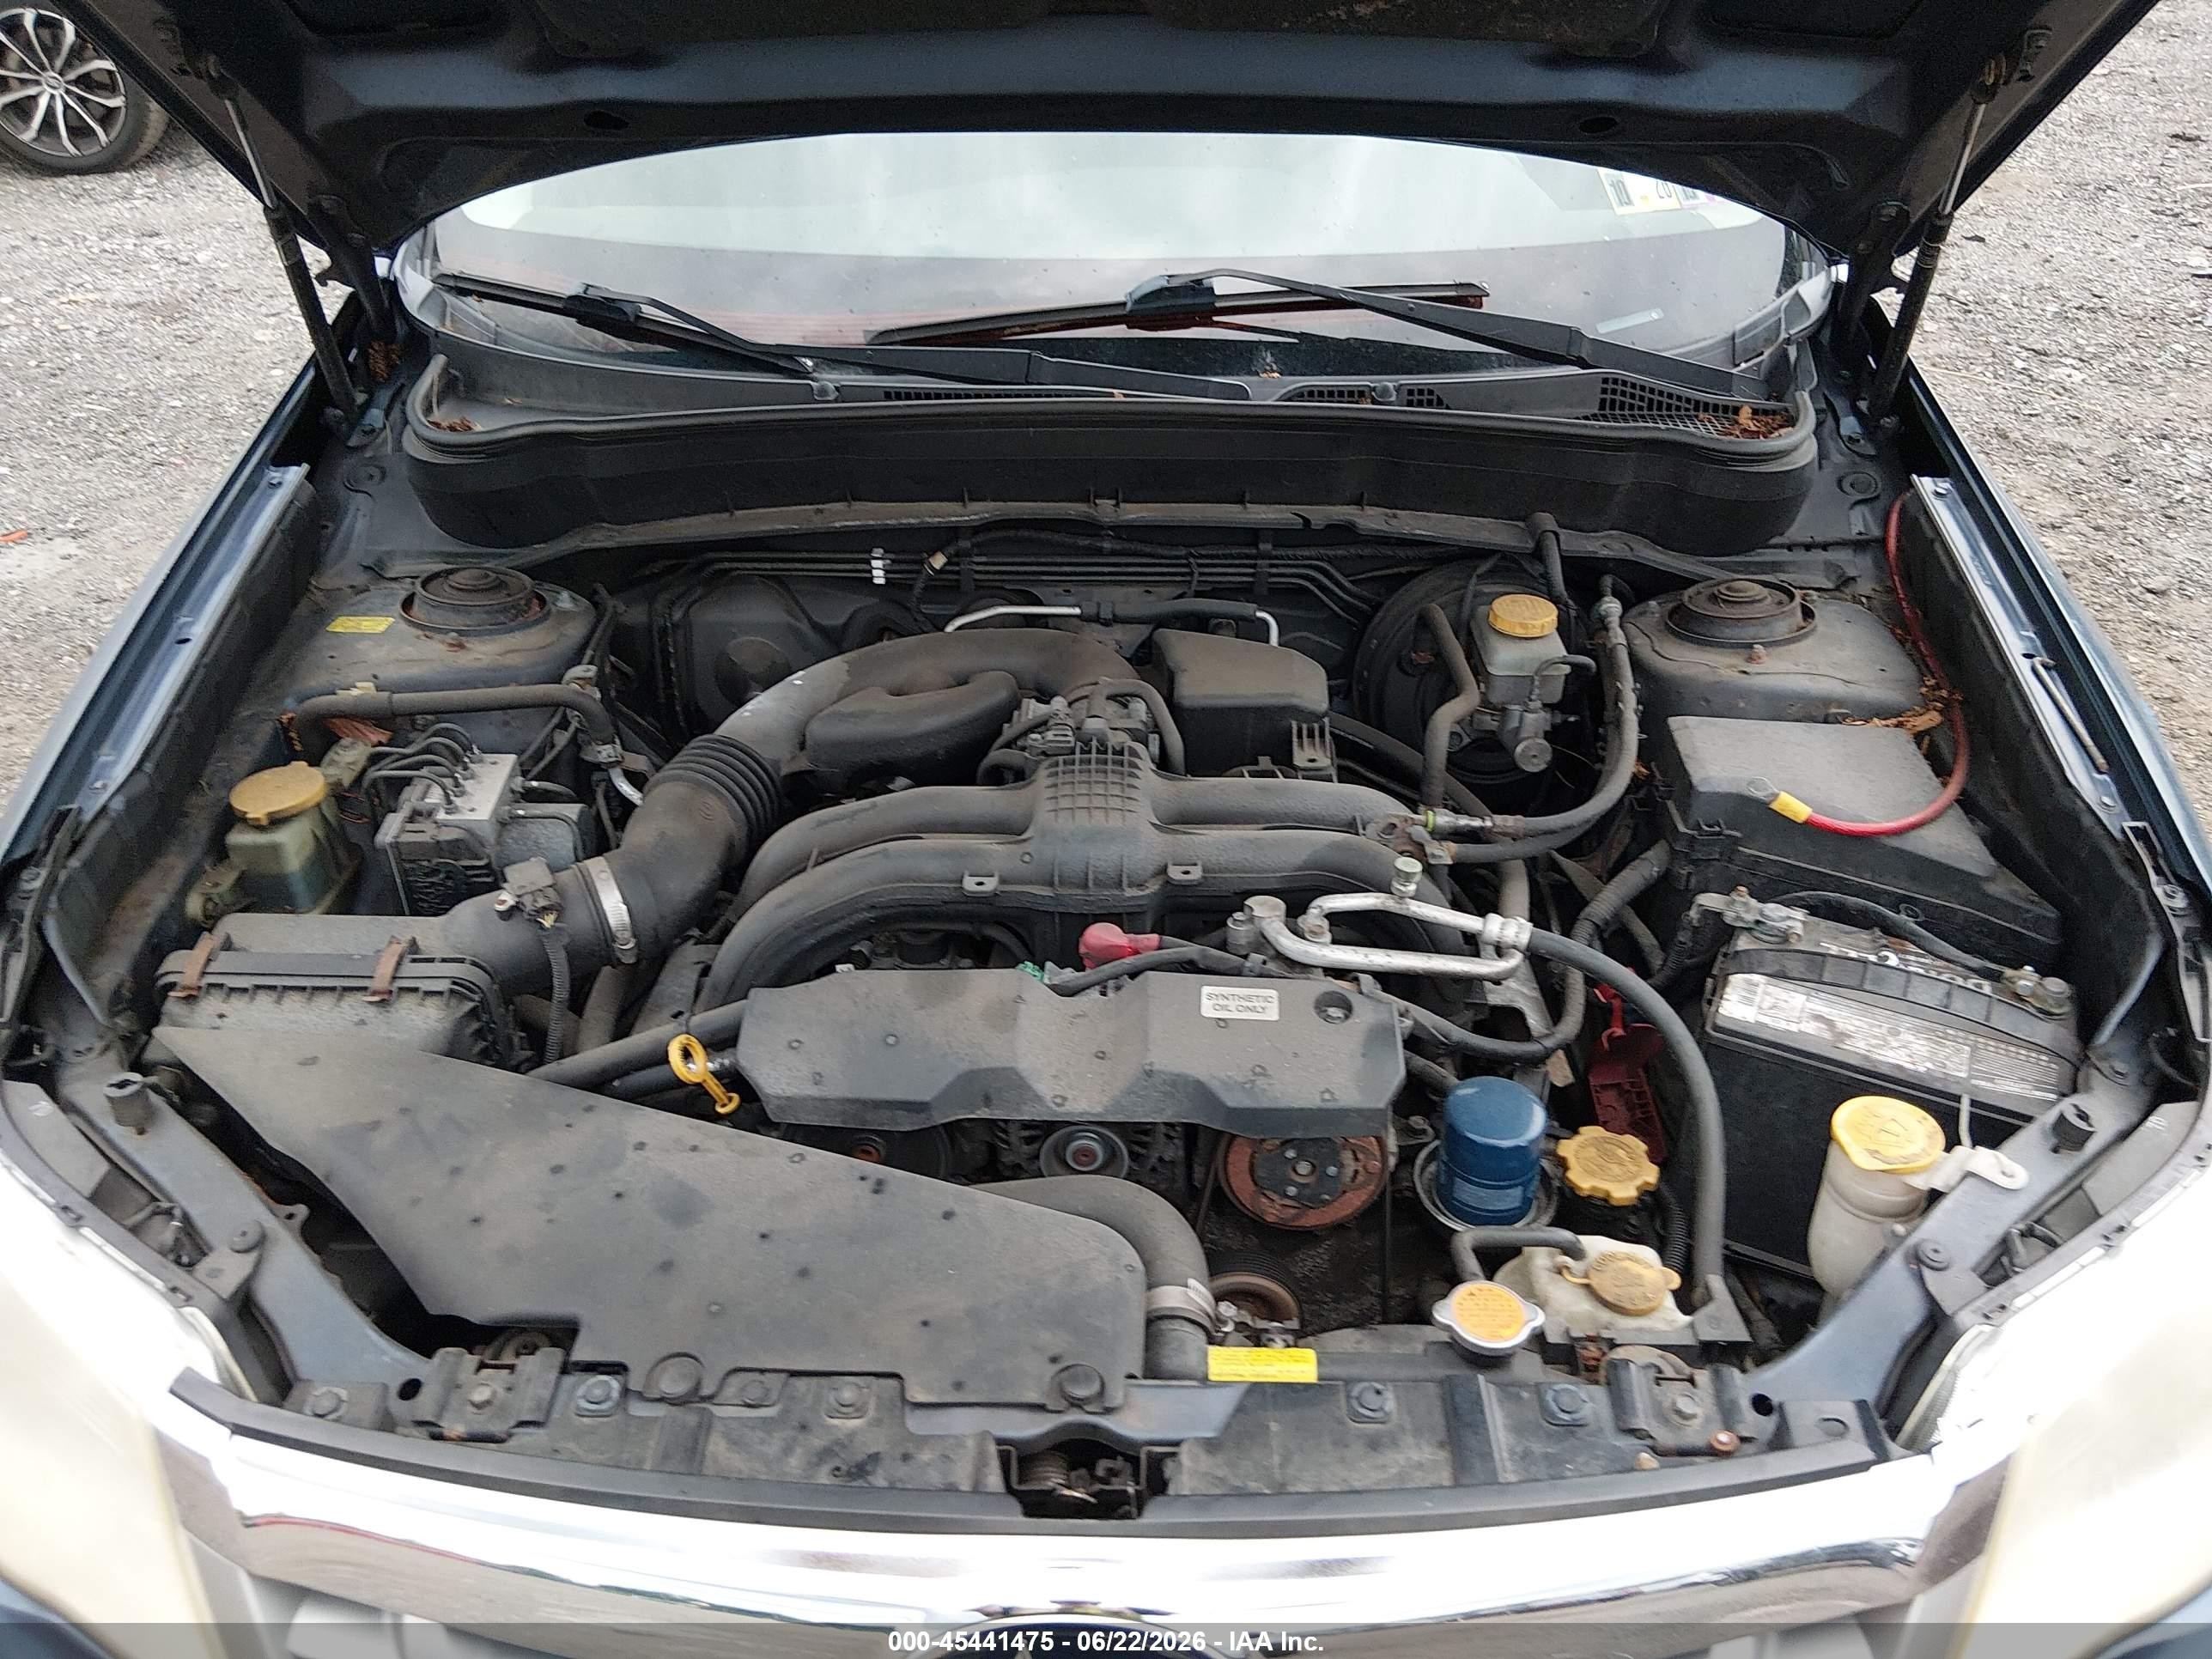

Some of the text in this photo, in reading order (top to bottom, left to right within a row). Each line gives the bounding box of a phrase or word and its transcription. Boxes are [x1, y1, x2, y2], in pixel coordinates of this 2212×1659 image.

[1206, 992, 1275, 1006] SYNTHETIC
[1212, 1003, 1267, 1015] OIL ONLY
